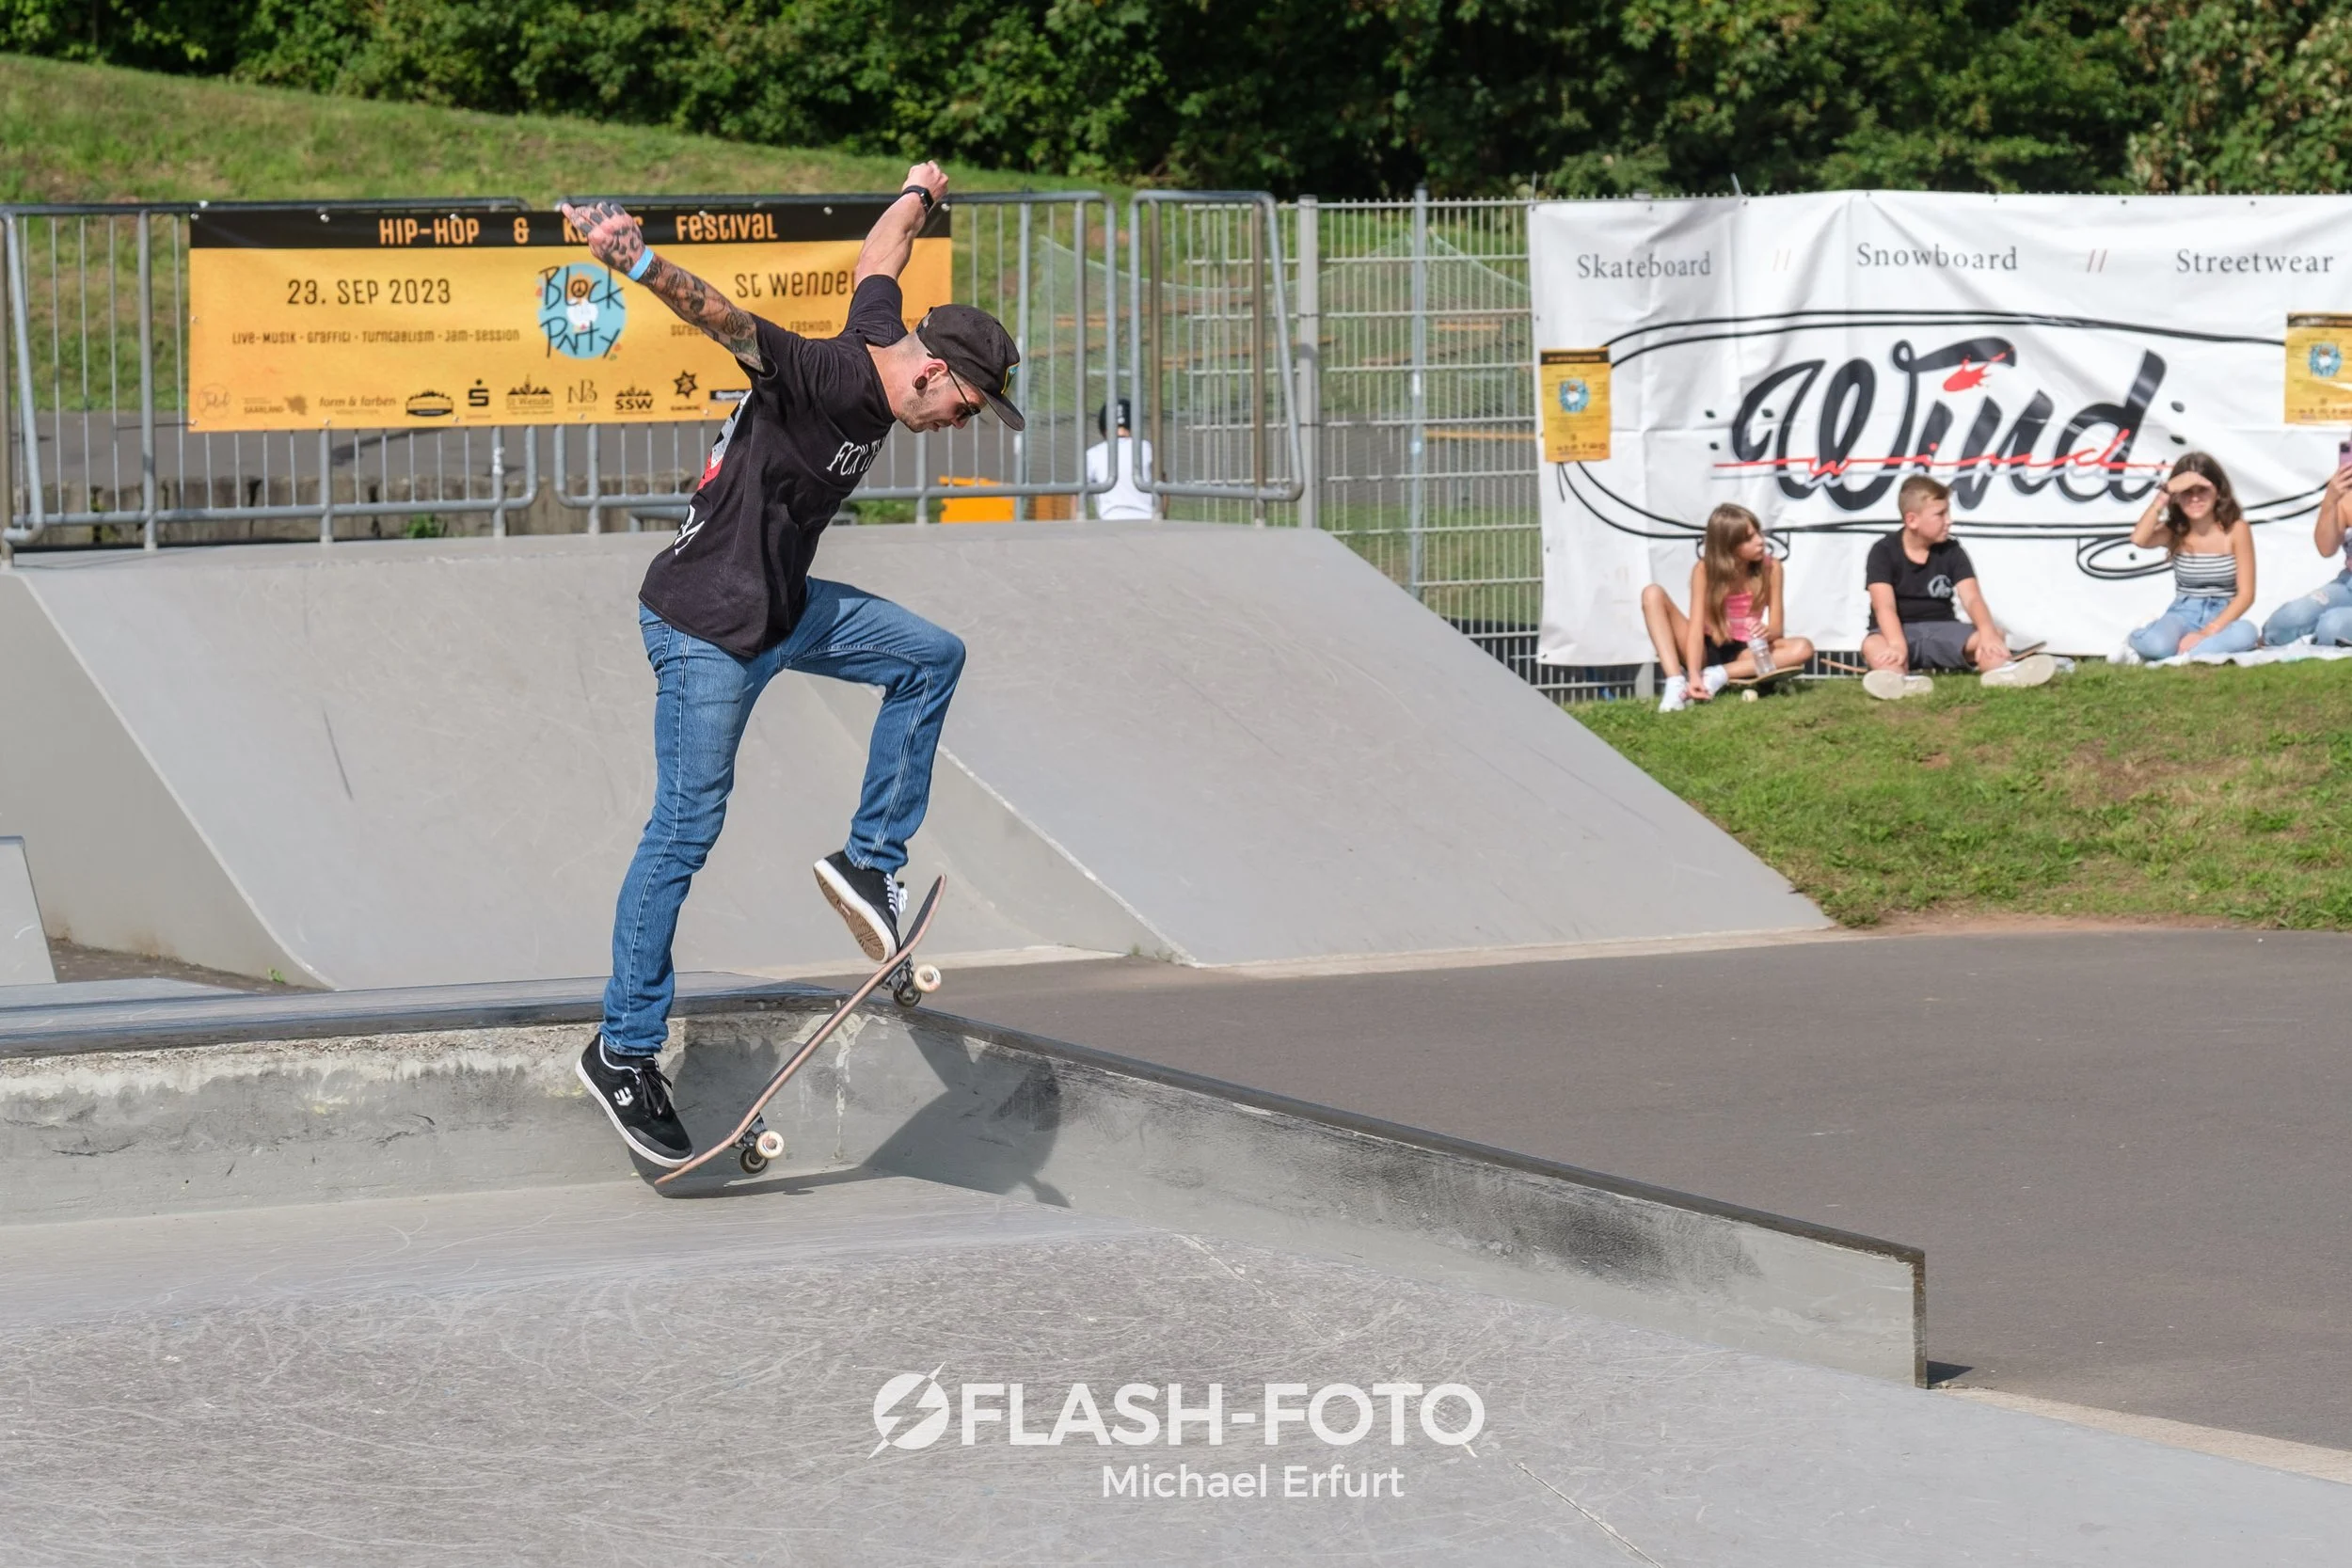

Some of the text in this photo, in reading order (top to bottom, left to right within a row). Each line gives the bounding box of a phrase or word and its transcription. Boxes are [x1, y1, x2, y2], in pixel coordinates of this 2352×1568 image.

[378, 216, 480, 245] HIP-HOP
[514, 216, 530, 245] &
[1577, 251, 1711, 279] Skateboard
[1856, 242, 2019, 271] Snowboard
[2176, 247, 2335, 274] Streetwear
[287, 277, 452, 305] 23. SEP 2023
[615, 397, 654, 411] SSW
[1731, 336, 2166, 511] Wind
